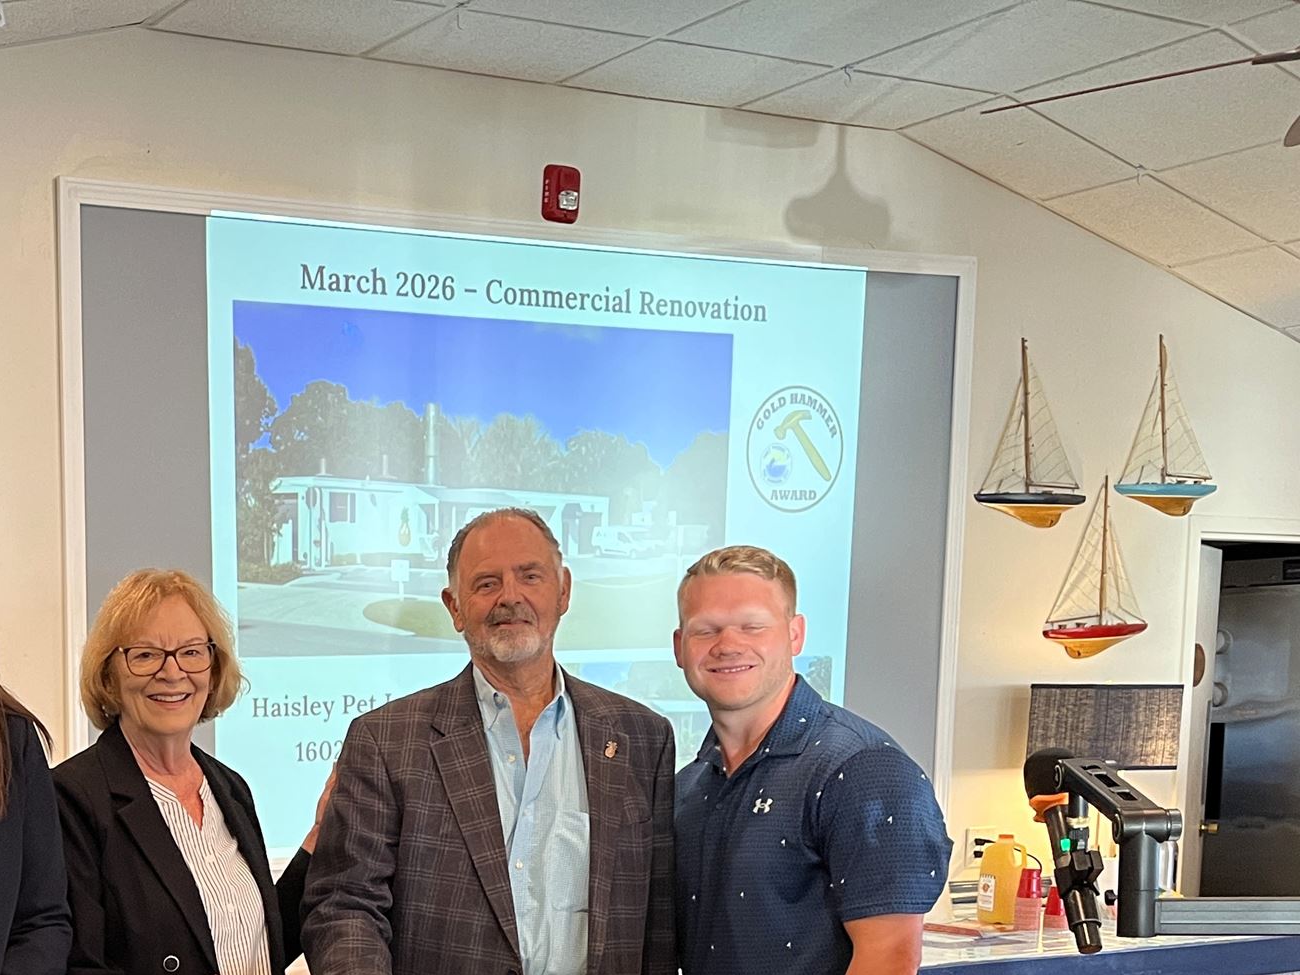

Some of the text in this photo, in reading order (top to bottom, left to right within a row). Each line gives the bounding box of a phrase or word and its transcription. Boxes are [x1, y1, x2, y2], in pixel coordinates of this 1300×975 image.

[300, 263, 388, 296] March
[396, 271, 456, 301] 2026
[486, 279, 632, 314] Commercial
[639, 290, 768, 322] Renovation
[756, 392, 838, 439] GOLD HAMMER
[770, 489, 817, 501] AWARD
[252, 693, 377, 723] Haisley Pet
